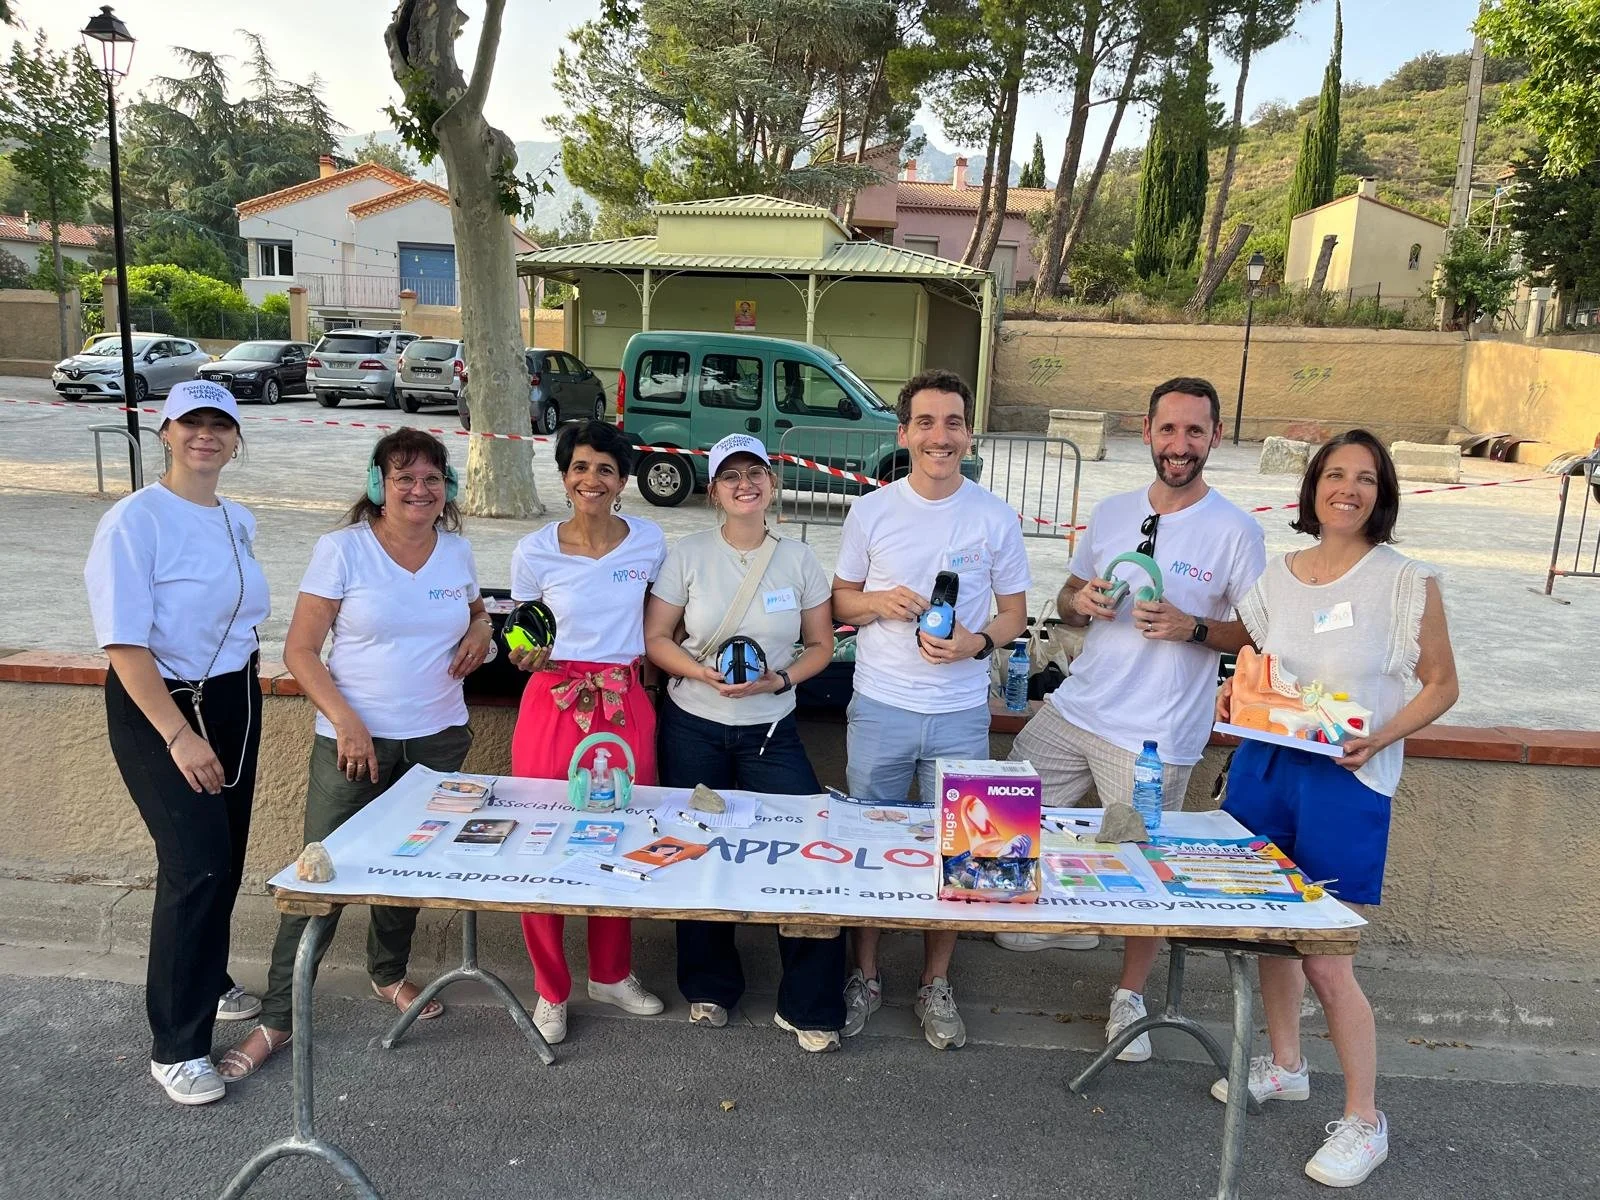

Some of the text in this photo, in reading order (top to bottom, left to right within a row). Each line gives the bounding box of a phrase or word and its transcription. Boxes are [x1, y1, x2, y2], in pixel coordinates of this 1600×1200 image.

[182, 384, 228, 397] FONDATION
[188, 389, 224, 399] MISSION
[950, 553, 980, 568] APPOLO
[612, 569, 648, 583] APPOLO
[1170, 560, 1213, 582] APPOLO
[428, 588, 462, 601] APPOLO
[987, 786, 1035, 797] MOLDEX
[690, 836, 936, 870] APPOLO
[760, 886, 850, 896] email:
